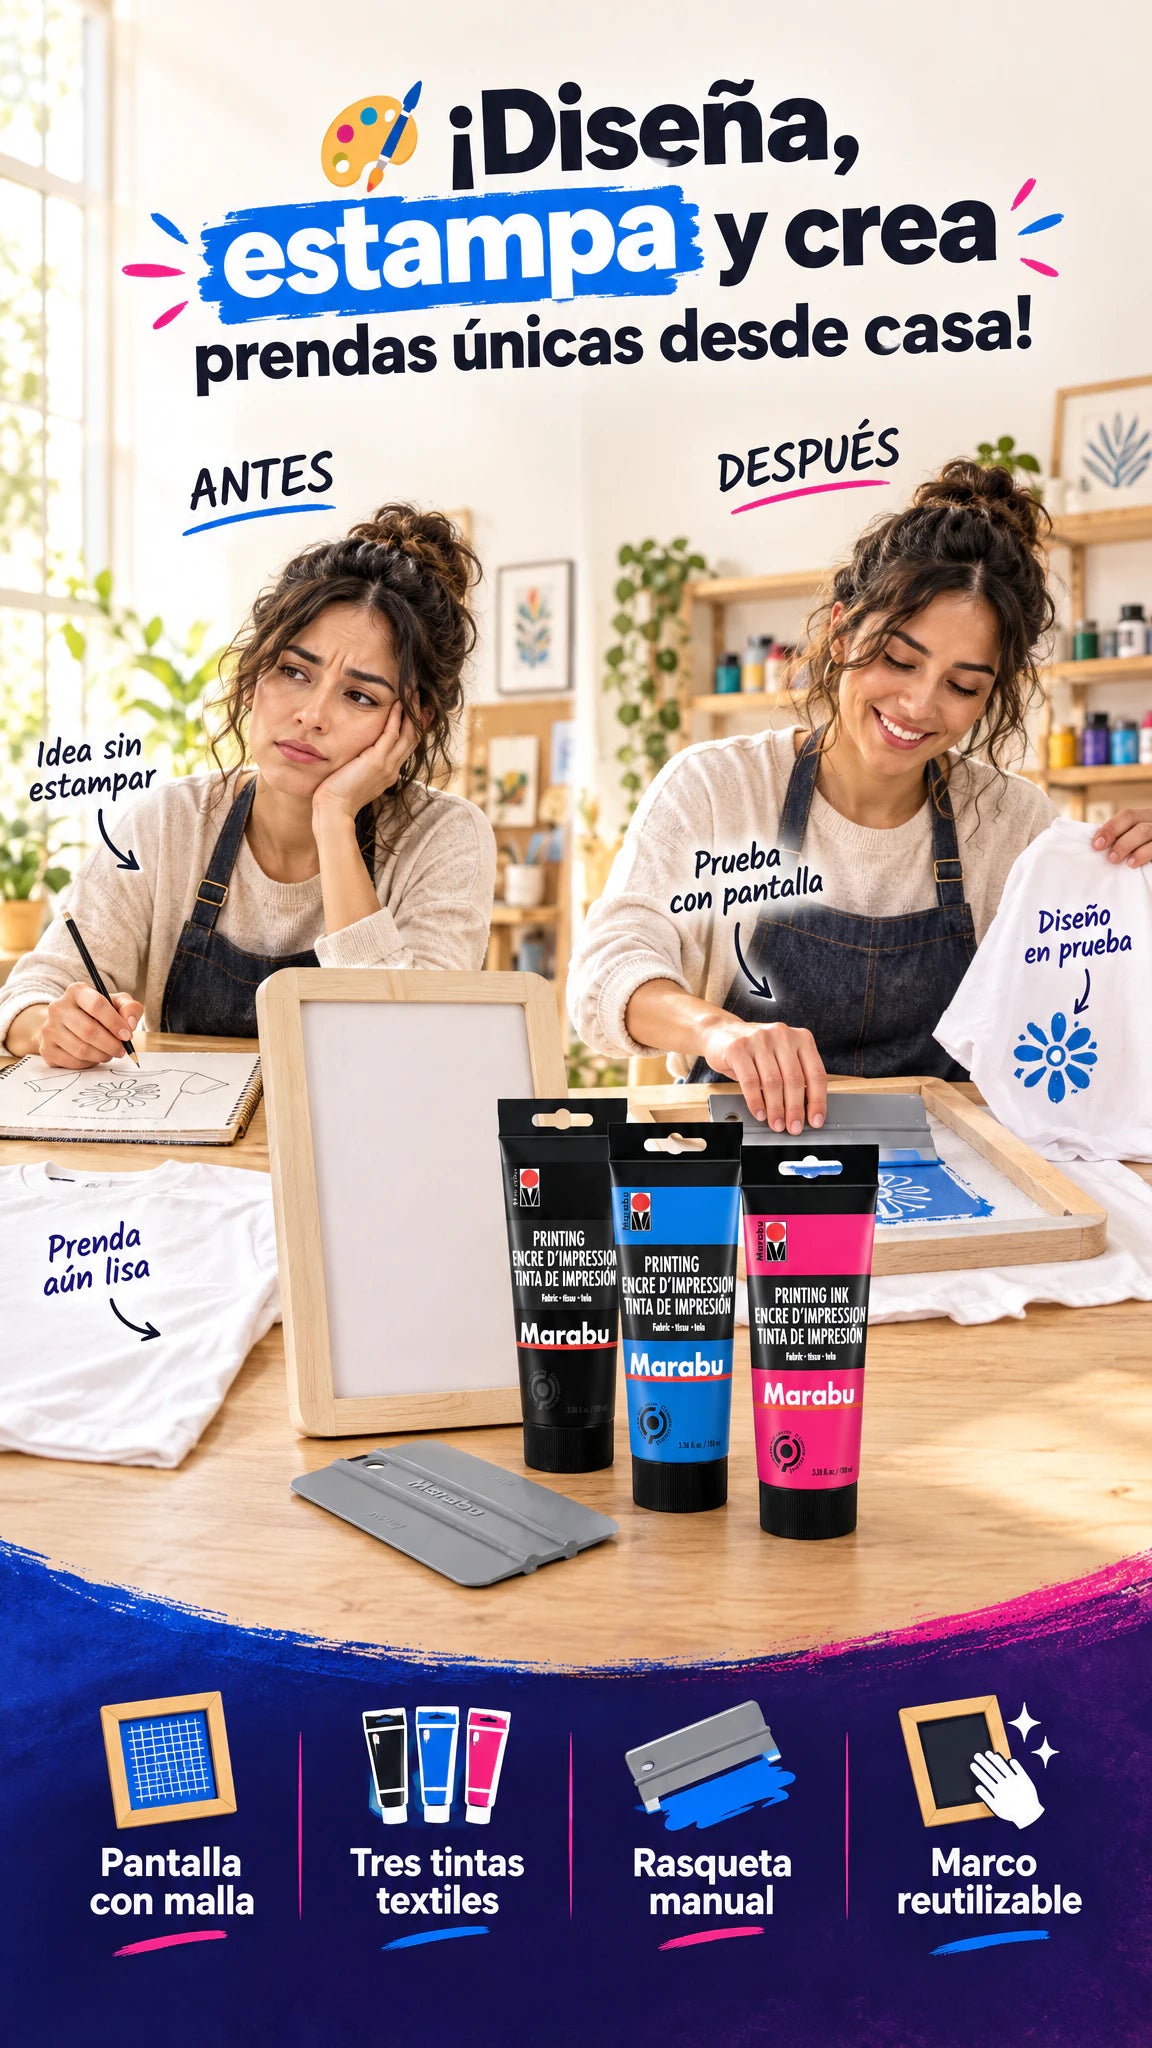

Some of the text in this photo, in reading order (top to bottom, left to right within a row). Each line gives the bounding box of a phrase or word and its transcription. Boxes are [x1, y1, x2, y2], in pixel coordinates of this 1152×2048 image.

[533, 1231, 585, 1248] PRINTING
[512, 1249, 618, 1268] ENCRE D'IMPRESSION
[644, 1255, 700, 1274] PRINTING
[514, 1266, 617, 1287] TINTA DE IMPRESIÓN
[621, 1276, 735, 1295] ENCRE D'IMPRESSION
[624, 1294, 731, 1316] TINTA DE IMPRESIÓN
[775, 1286, 850, 1304] PRINTING INK
[754, 1306, 867, 1325] ENCRE D'IMPRESSION
[520, 1321, 610, 1345] Marabu
[757, 1323, 863, 1346] TINTA DE IMPRESIÓN
[630, 1352, 724, 1378] Marabu
[763, 1380, 855, 1407] Marabu
